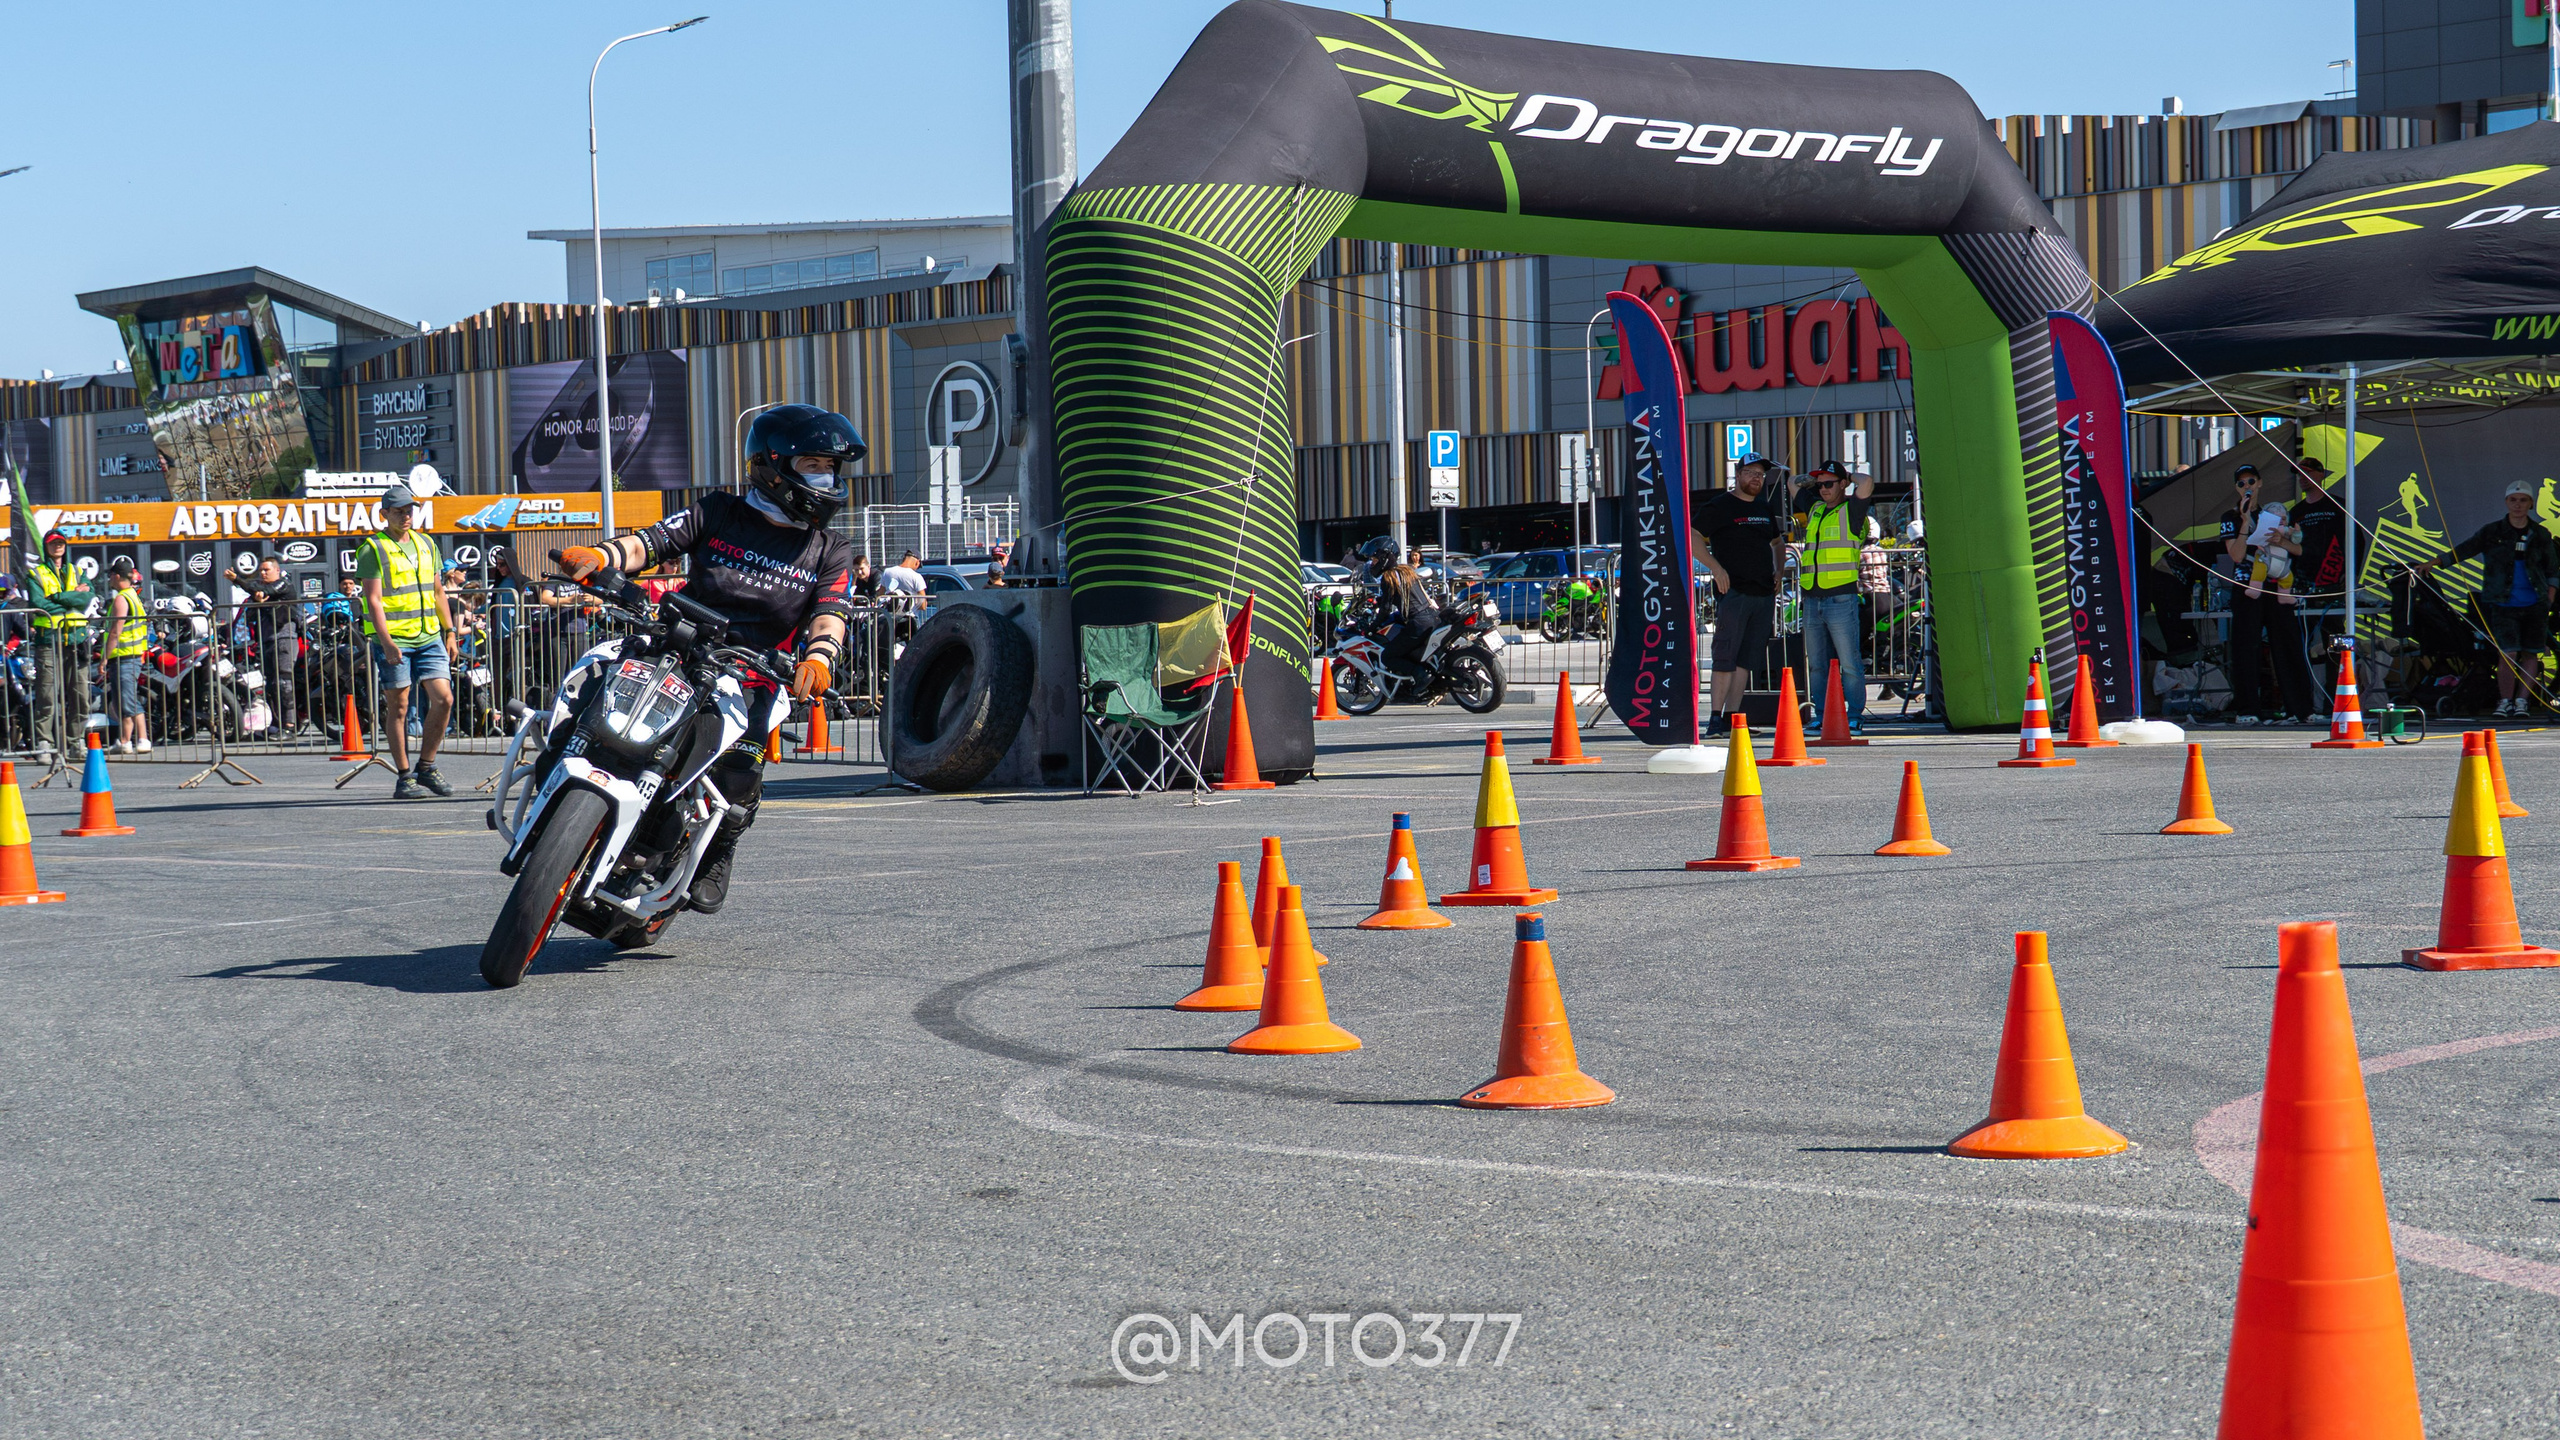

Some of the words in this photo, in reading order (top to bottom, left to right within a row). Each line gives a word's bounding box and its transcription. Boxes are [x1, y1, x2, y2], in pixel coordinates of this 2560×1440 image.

[1509, 94, 1943, 176] Dragonfly
[2446, 205, 2560, 230] Dr
[373, 383, 426, 416] ВКУСНЫЙ
[944, 379, 985, 447] P
[545, 420, 583, 437] HONOR
[1653, 405, 1664, 479] TEAM
[1734, 429, 1748, 456] P
[1437, 436, 1455, 464] P
[1904, 448, 1916, 462] 10
[2086, 411, 2096, 478] TEAM
[99, 456, 128, 476] LIME
[60, 510, 114, 523] АВТО
[170, 500, 434, 536] АВТОЗАПЧАСИ
[516, 511, 600, 524] ЕВРОПЕЕЦ
[519, 499, 565, 511] АВТО
[2220, 521, 2235, 534] 33
[708, 537, 818, 583] MOTOGYMKHANA
[711, 554, 806, 593] EKATERINBURG
[1627, 407, 1662, 728] MOTOGYMKHANA
[738, 573, 773, 591] TEAM
[1658, 503, 1675, 728] EKATERINBURG
[2088, 500, 2116, 703] EKATERINBURG
[628, 667, 652, 680] 23
